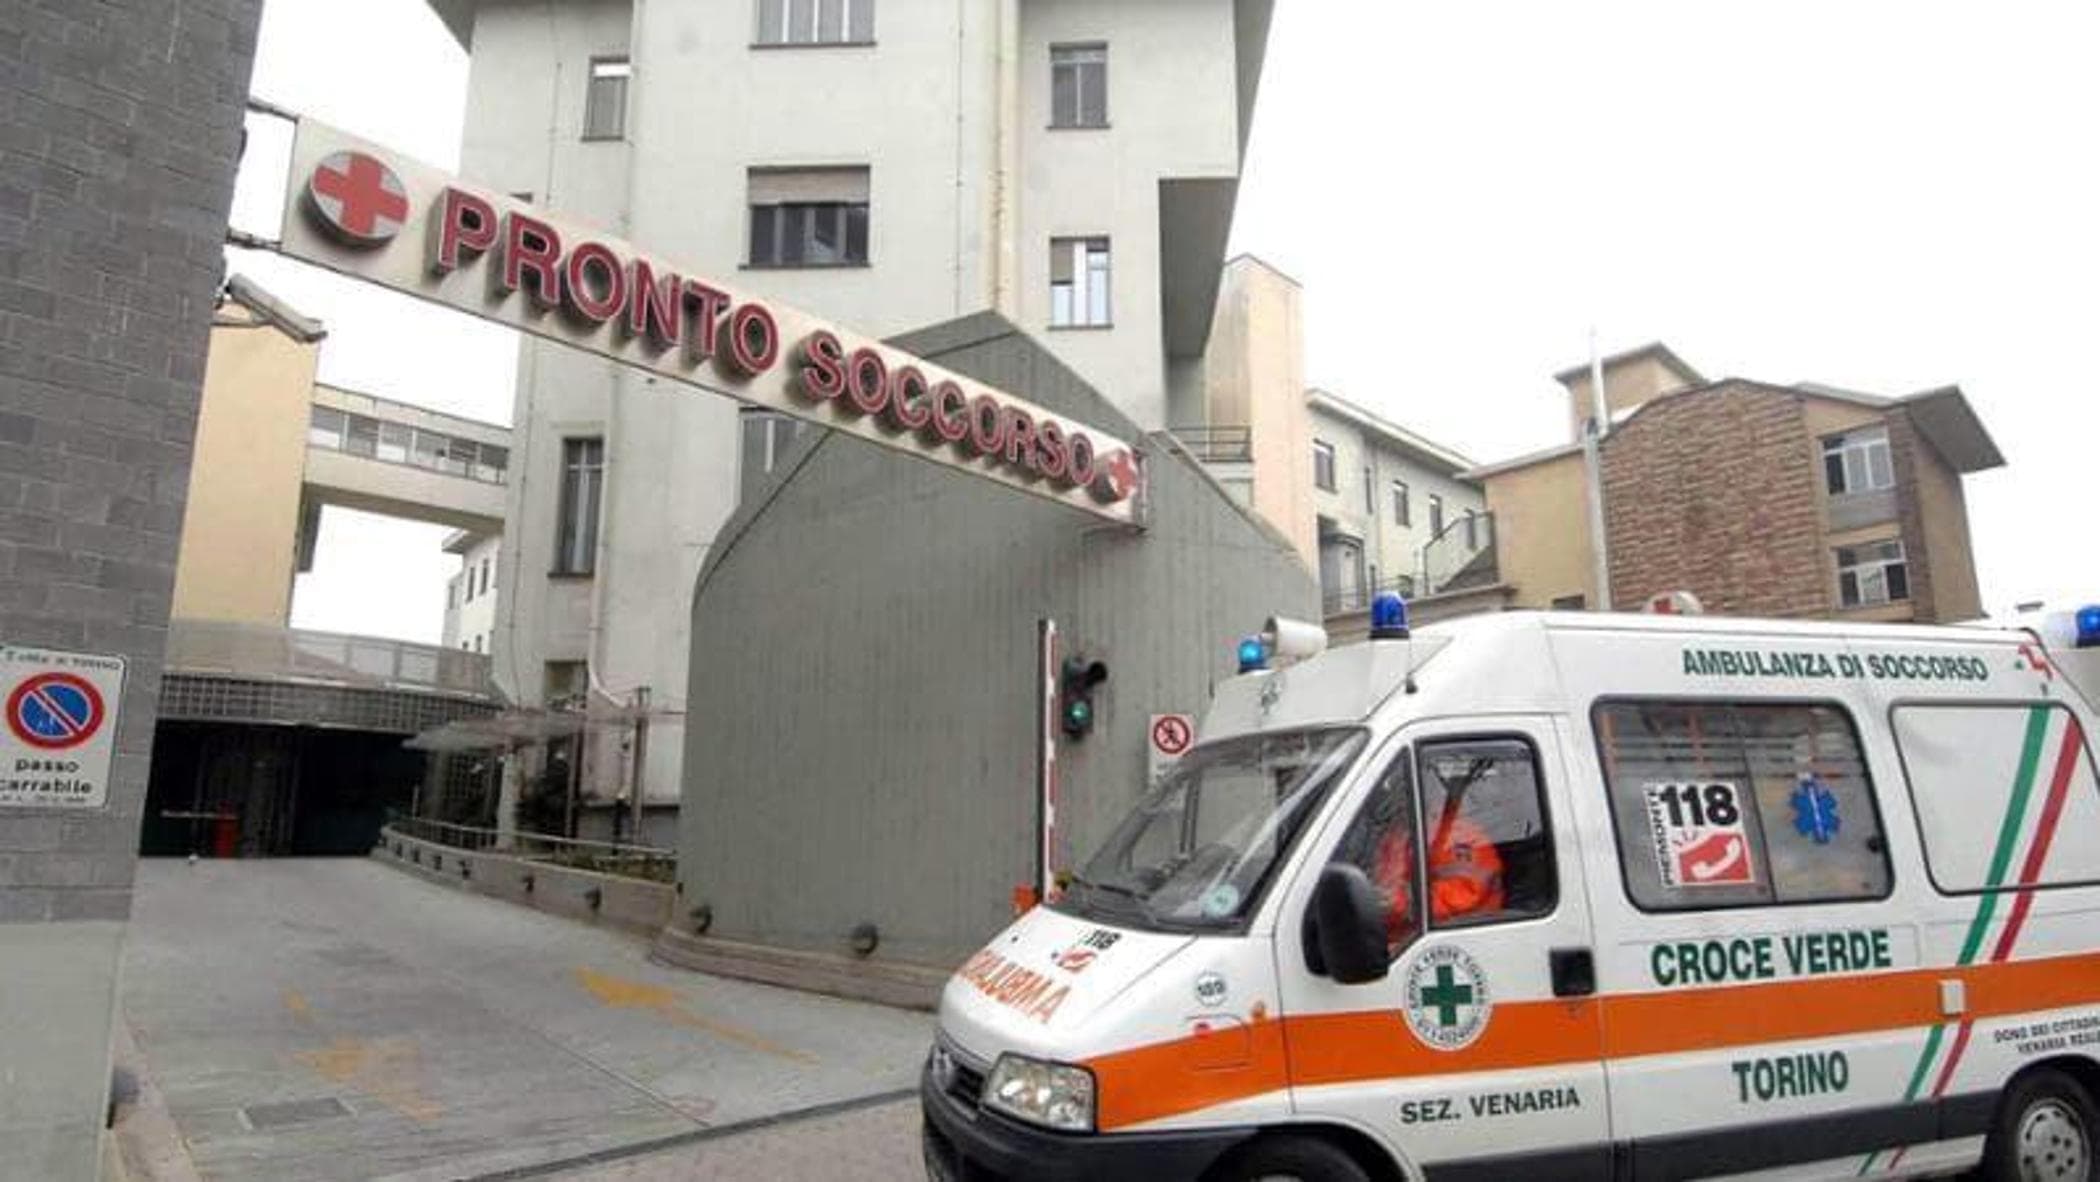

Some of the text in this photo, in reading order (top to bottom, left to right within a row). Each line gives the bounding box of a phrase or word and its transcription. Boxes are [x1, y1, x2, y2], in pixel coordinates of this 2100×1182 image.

[438, 185, 1094, 486] PRONTO SOCCORSO
[1682, 650, 1988, 681] AMBULANZA DI SOCCORSO
[15, 758, 79, 773] passo
[1660, 785, 1739, 826] 118
[1647, 791, 1674, 886] PIEMONTE
[1651, 930, 1892, 986] CROCE VERDE
[1732, 1051, 1849, 1103] TORINO
[1401, 1088, 1581, 1124] SEZ. VENARIA
